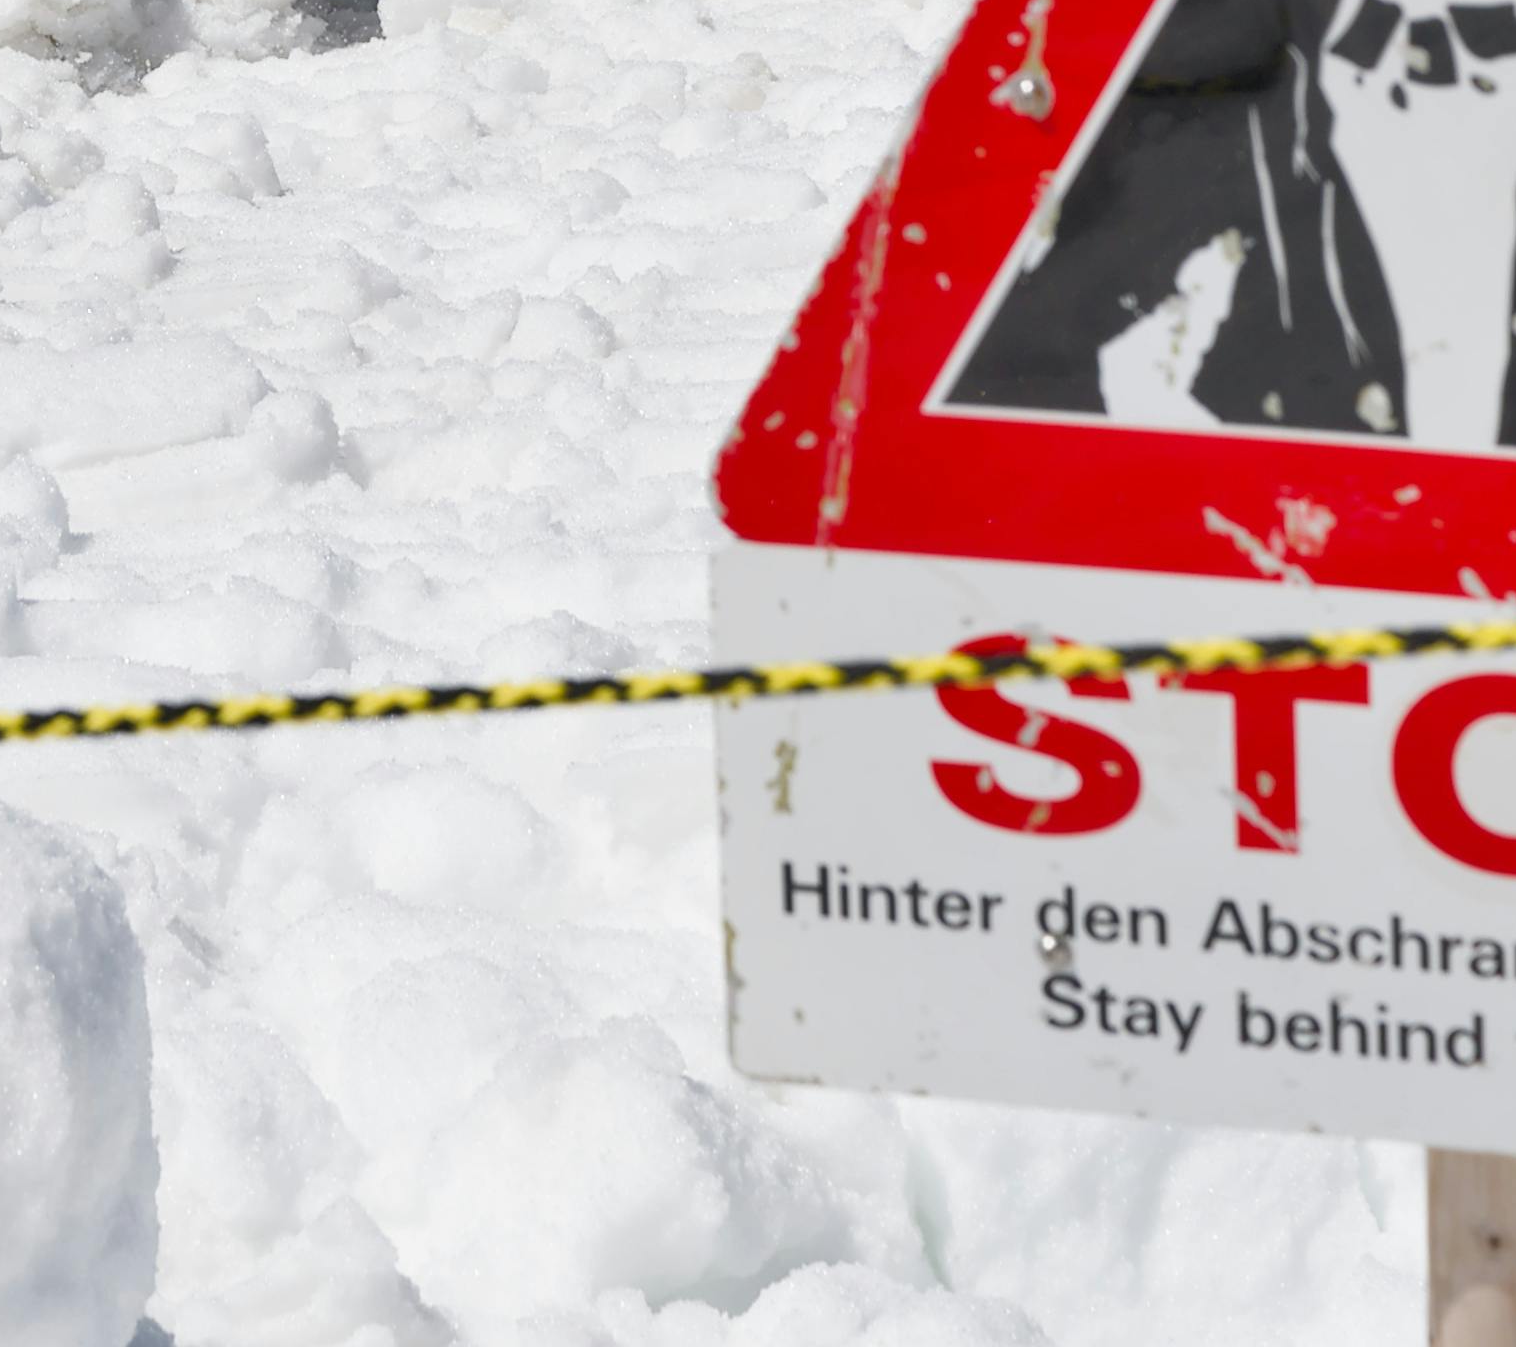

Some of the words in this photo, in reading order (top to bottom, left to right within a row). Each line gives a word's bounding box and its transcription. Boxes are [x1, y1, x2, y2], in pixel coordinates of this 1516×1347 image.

[779, 859, 1003, 934] Hinter
[1037, 885, 1169, 948] den
[1040, 972, 1204, 1054] Stay
[1237, 991, 1486, 1068] behind
